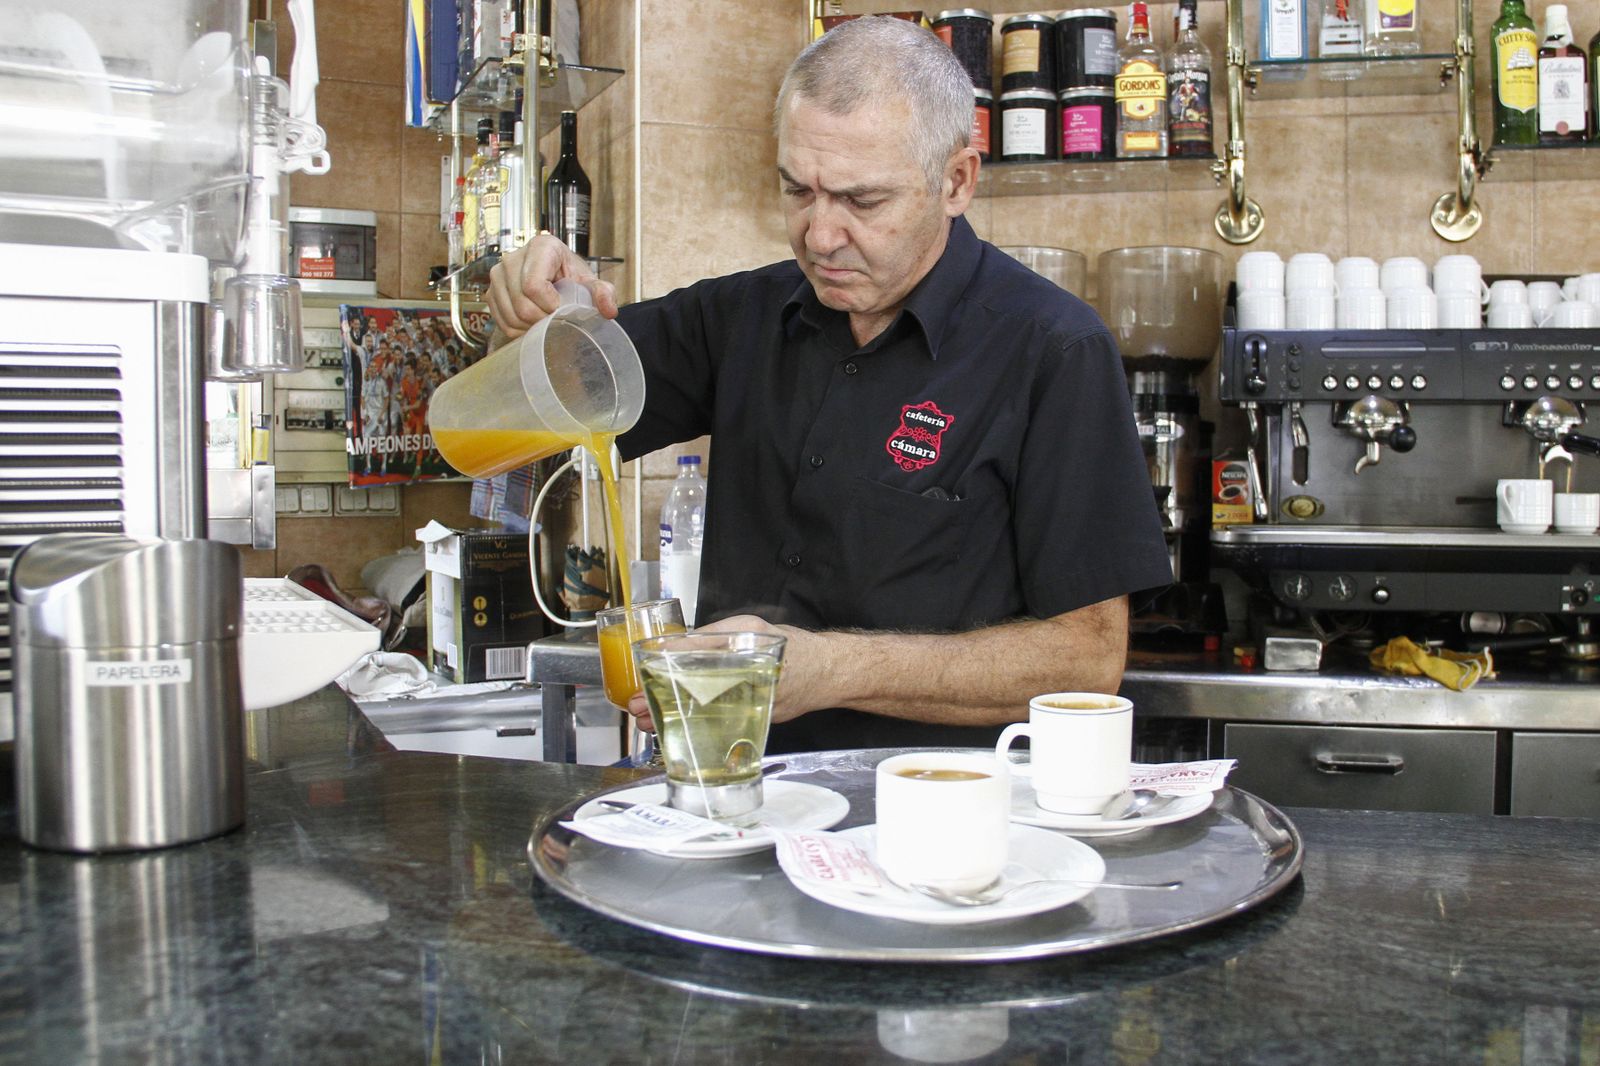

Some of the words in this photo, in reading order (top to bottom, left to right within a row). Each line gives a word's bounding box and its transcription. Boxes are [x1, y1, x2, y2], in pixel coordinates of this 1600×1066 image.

[1499, 33, 1524, 46] CUTTY
[906, 410, 945, 428] cafetería
[890, 439, 936, 459] cámara
[96, 665, 181, 680] PAPELERA
